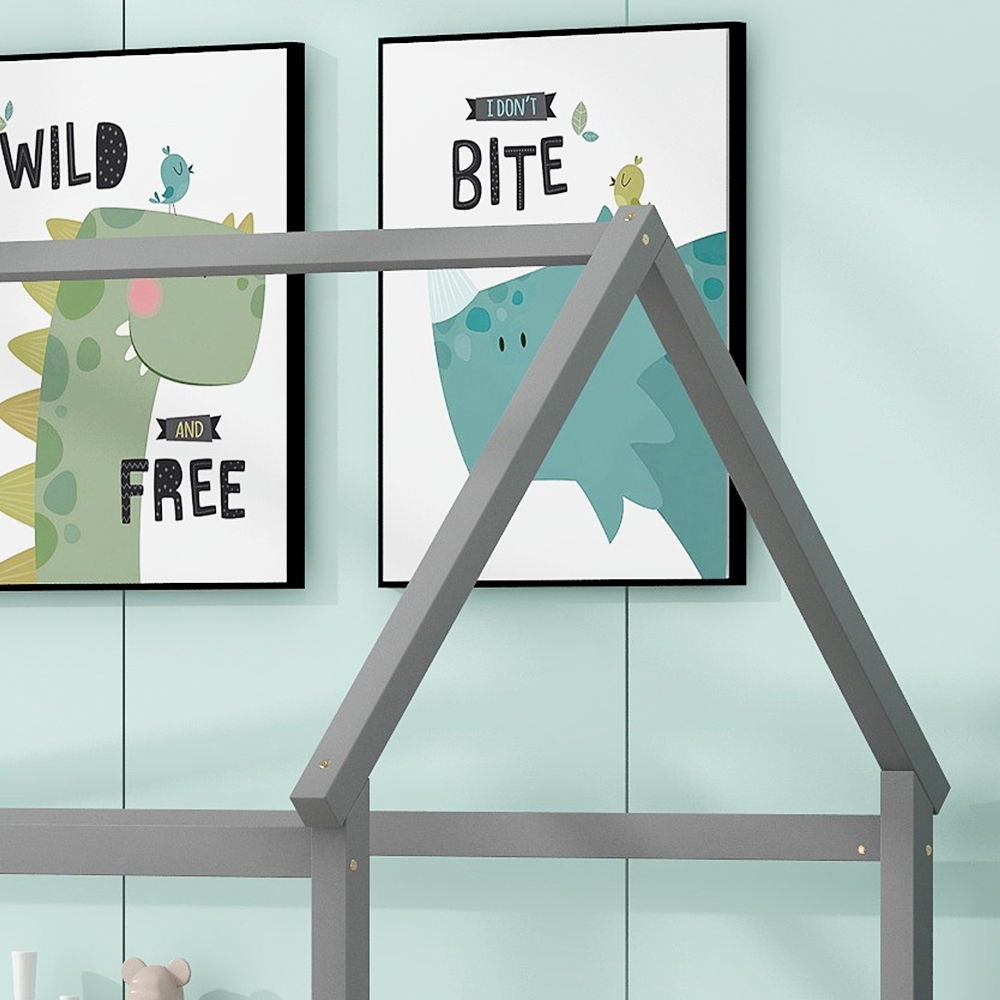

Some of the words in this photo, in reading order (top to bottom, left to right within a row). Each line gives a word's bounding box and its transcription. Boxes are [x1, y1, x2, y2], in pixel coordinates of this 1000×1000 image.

[486, 98, 494, 118] I
[496, 96, 538, 118] DON'T
[0, 121, 128, 190] WILD
[452, 136, 568, 211] BITE
[175, 420, 204, 439] AND
[120, 458, 246, 524] FREE
